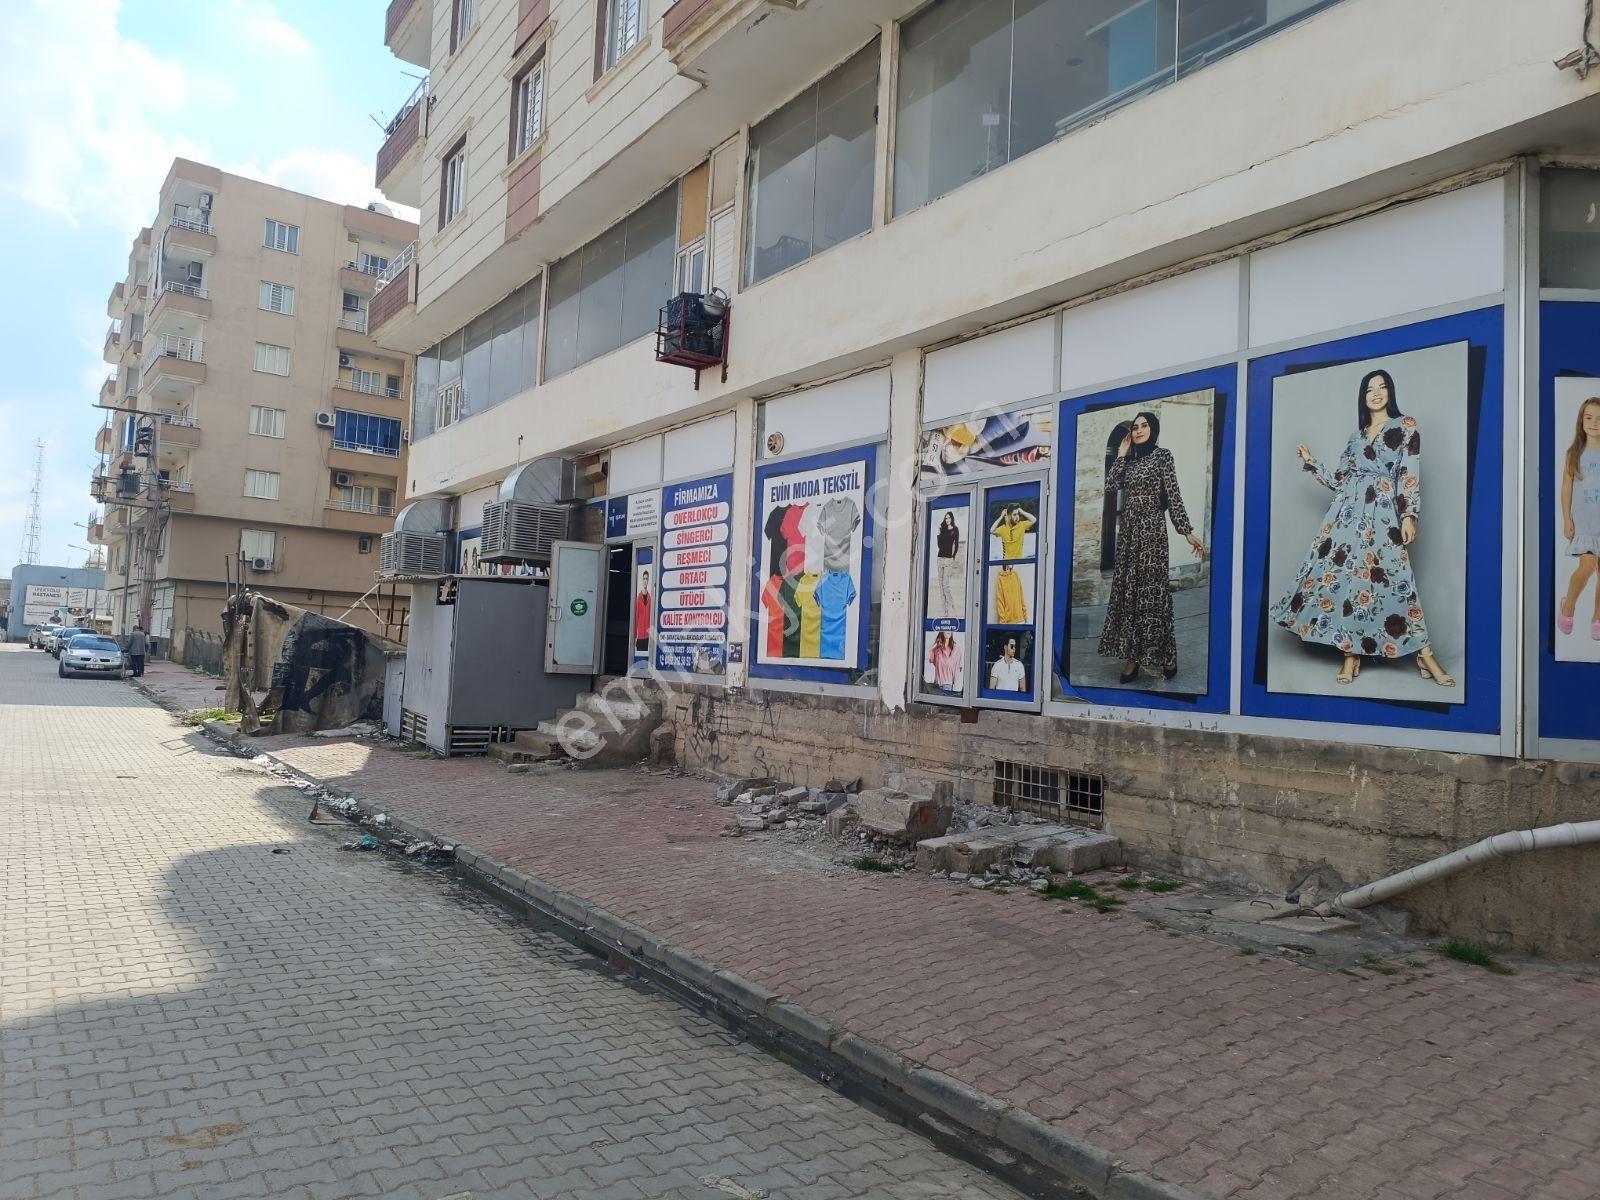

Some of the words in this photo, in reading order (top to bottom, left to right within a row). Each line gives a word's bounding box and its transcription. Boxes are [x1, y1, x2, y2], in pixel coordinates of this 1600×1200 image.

[674, 483, 718, 507] FİRMAMIZA
[770, 481, 790, 503] EVİN
[792, 478, 820, 500] MODA
[822, 469, 860, 493] TEKSTİL
